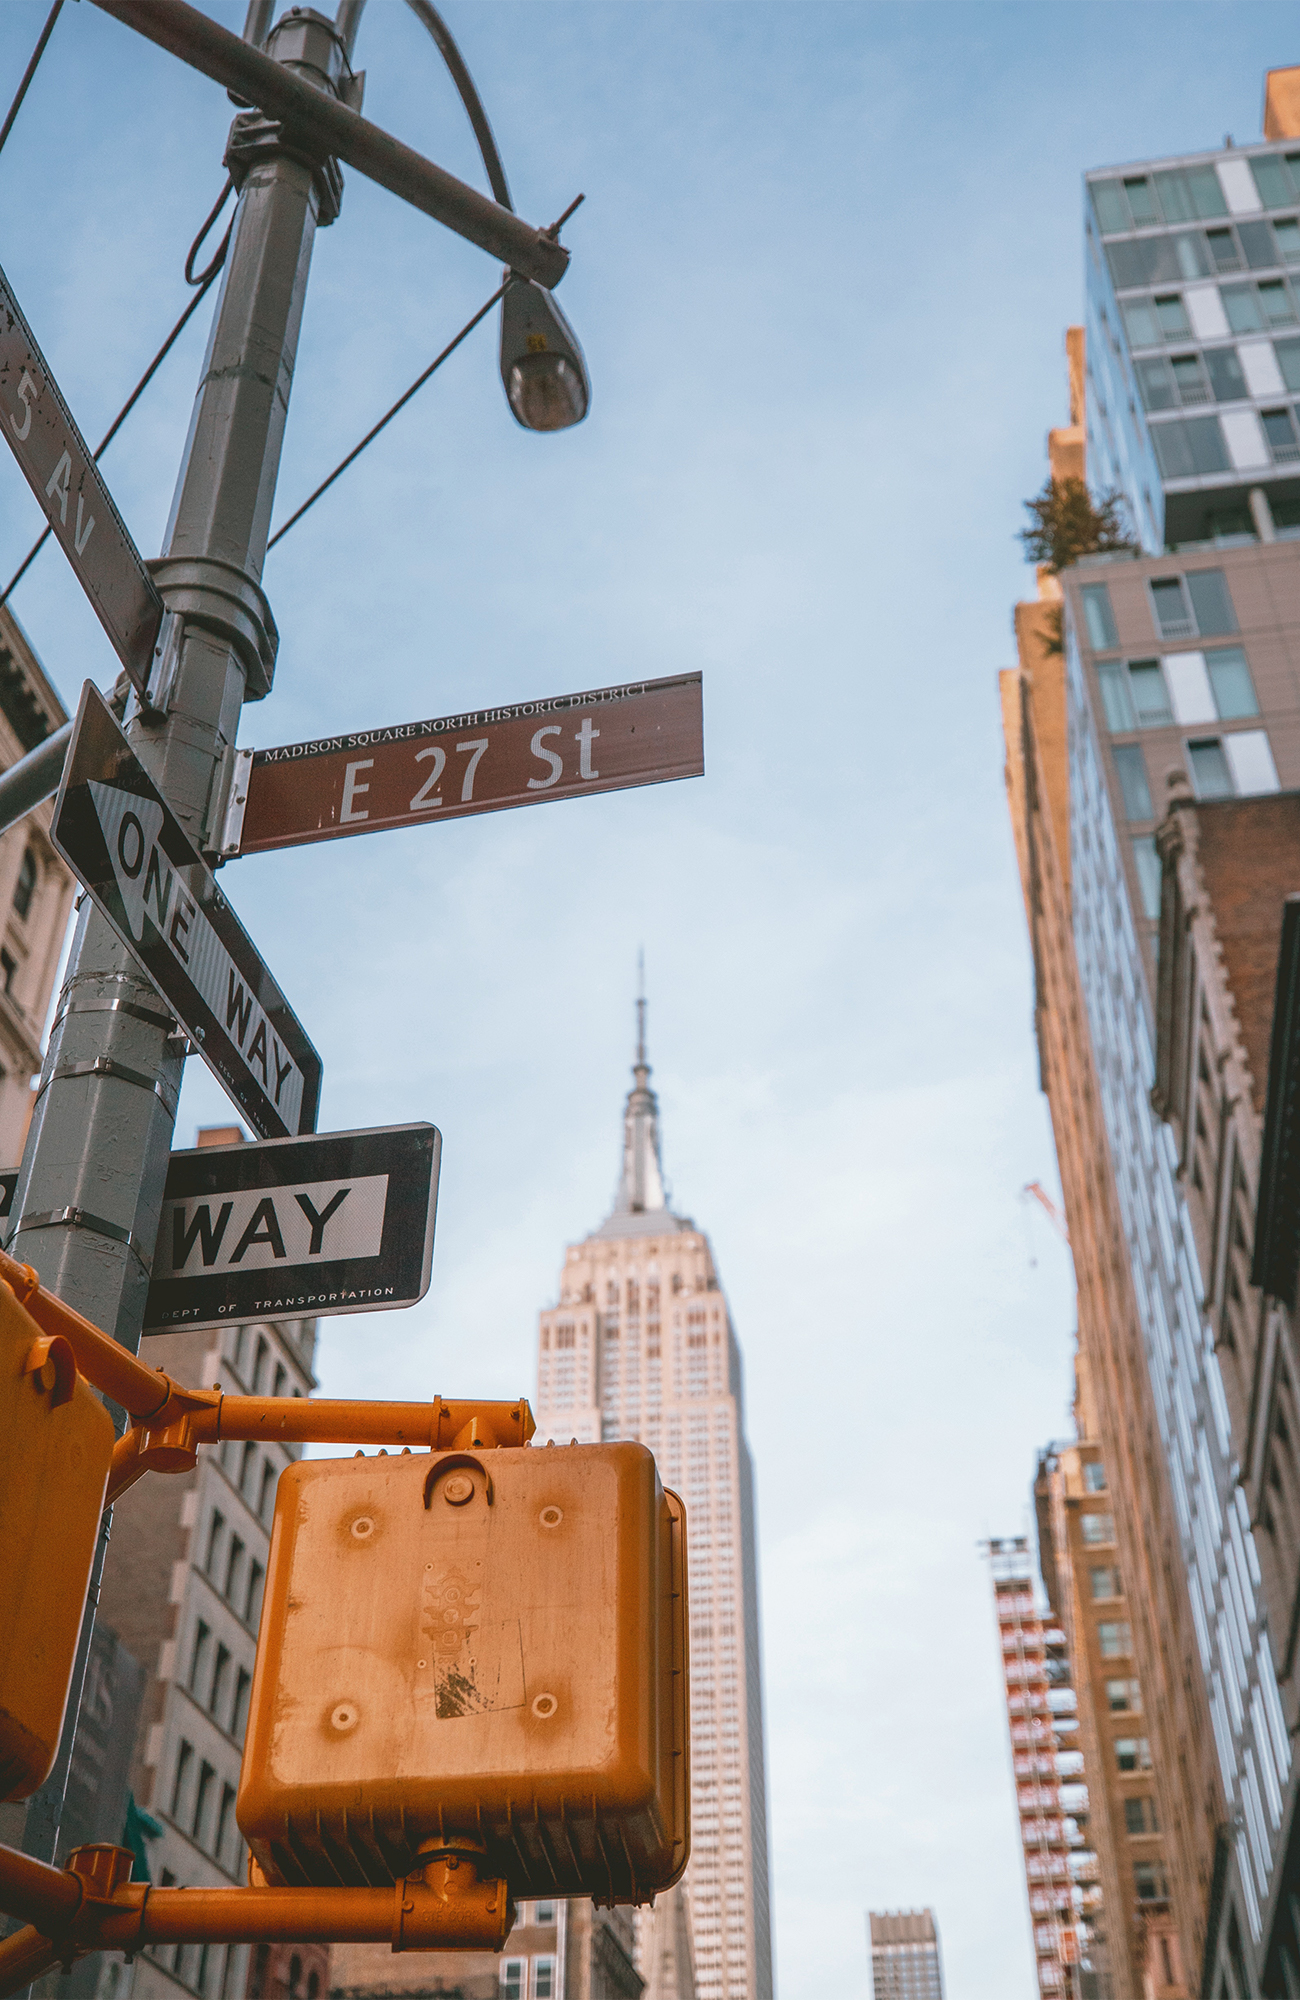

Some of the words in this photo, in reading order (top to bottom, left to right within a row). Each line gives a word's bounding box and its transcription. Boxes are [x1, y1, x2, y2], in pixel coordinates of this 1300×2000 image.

[9, 368, 38, 442] 5
[44, 450, 96, 557] AV
[264, 738, 343, 762] MADISON
[347, 724, 417, 748] SQUARE
[421, 713, 479, 734] NORTH
[484, 699, 565, 723] HISTORIC
[569, 682, 650, 708] DISTRICT
[339, 758, 375, 824] E
[409, 738, 490, 811] 27
[526, 717, 601, 790] St
[117, 811, 197, 966] ONE
[225, 966, 294, 1107] WAY
[172, 1188, 352, 1271] WAY
[161, 1308, 201, 1319] DEPT
[218, 1304, 237, 1314] OF
[254, 1286, 395, 1310] TRANSPORTATION
